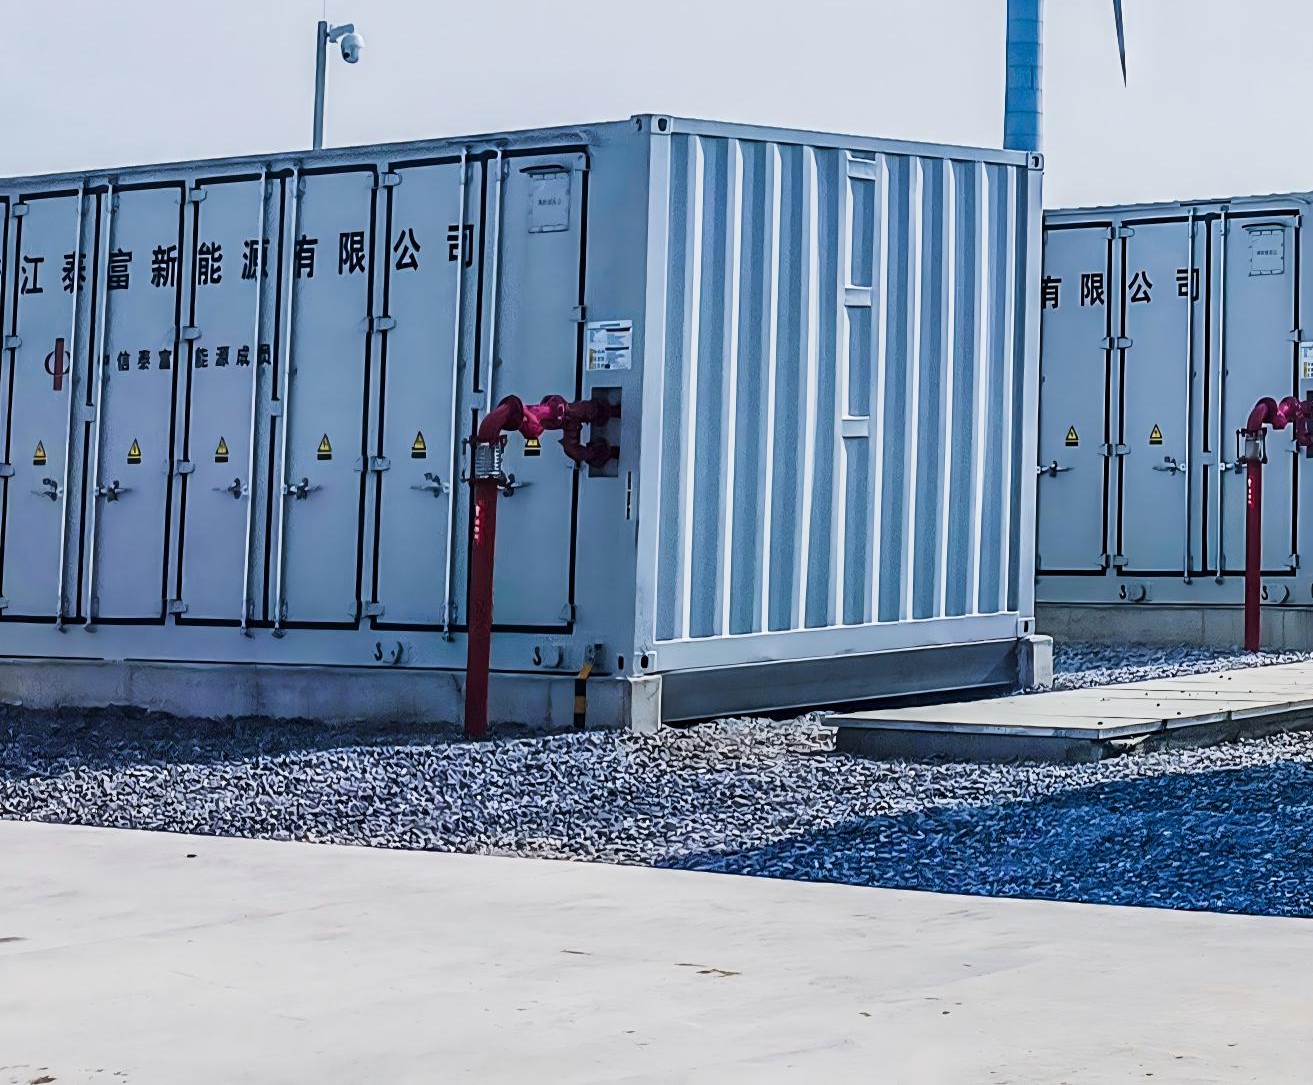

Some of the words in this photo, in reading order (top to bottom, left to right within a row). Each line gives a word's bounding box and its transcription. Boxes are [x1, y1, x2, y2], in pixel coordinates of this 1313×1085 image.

[0, 224, 474, 295] 江泰富新能源有限公司
[1041, 268, 1200, 310] 有限公司
